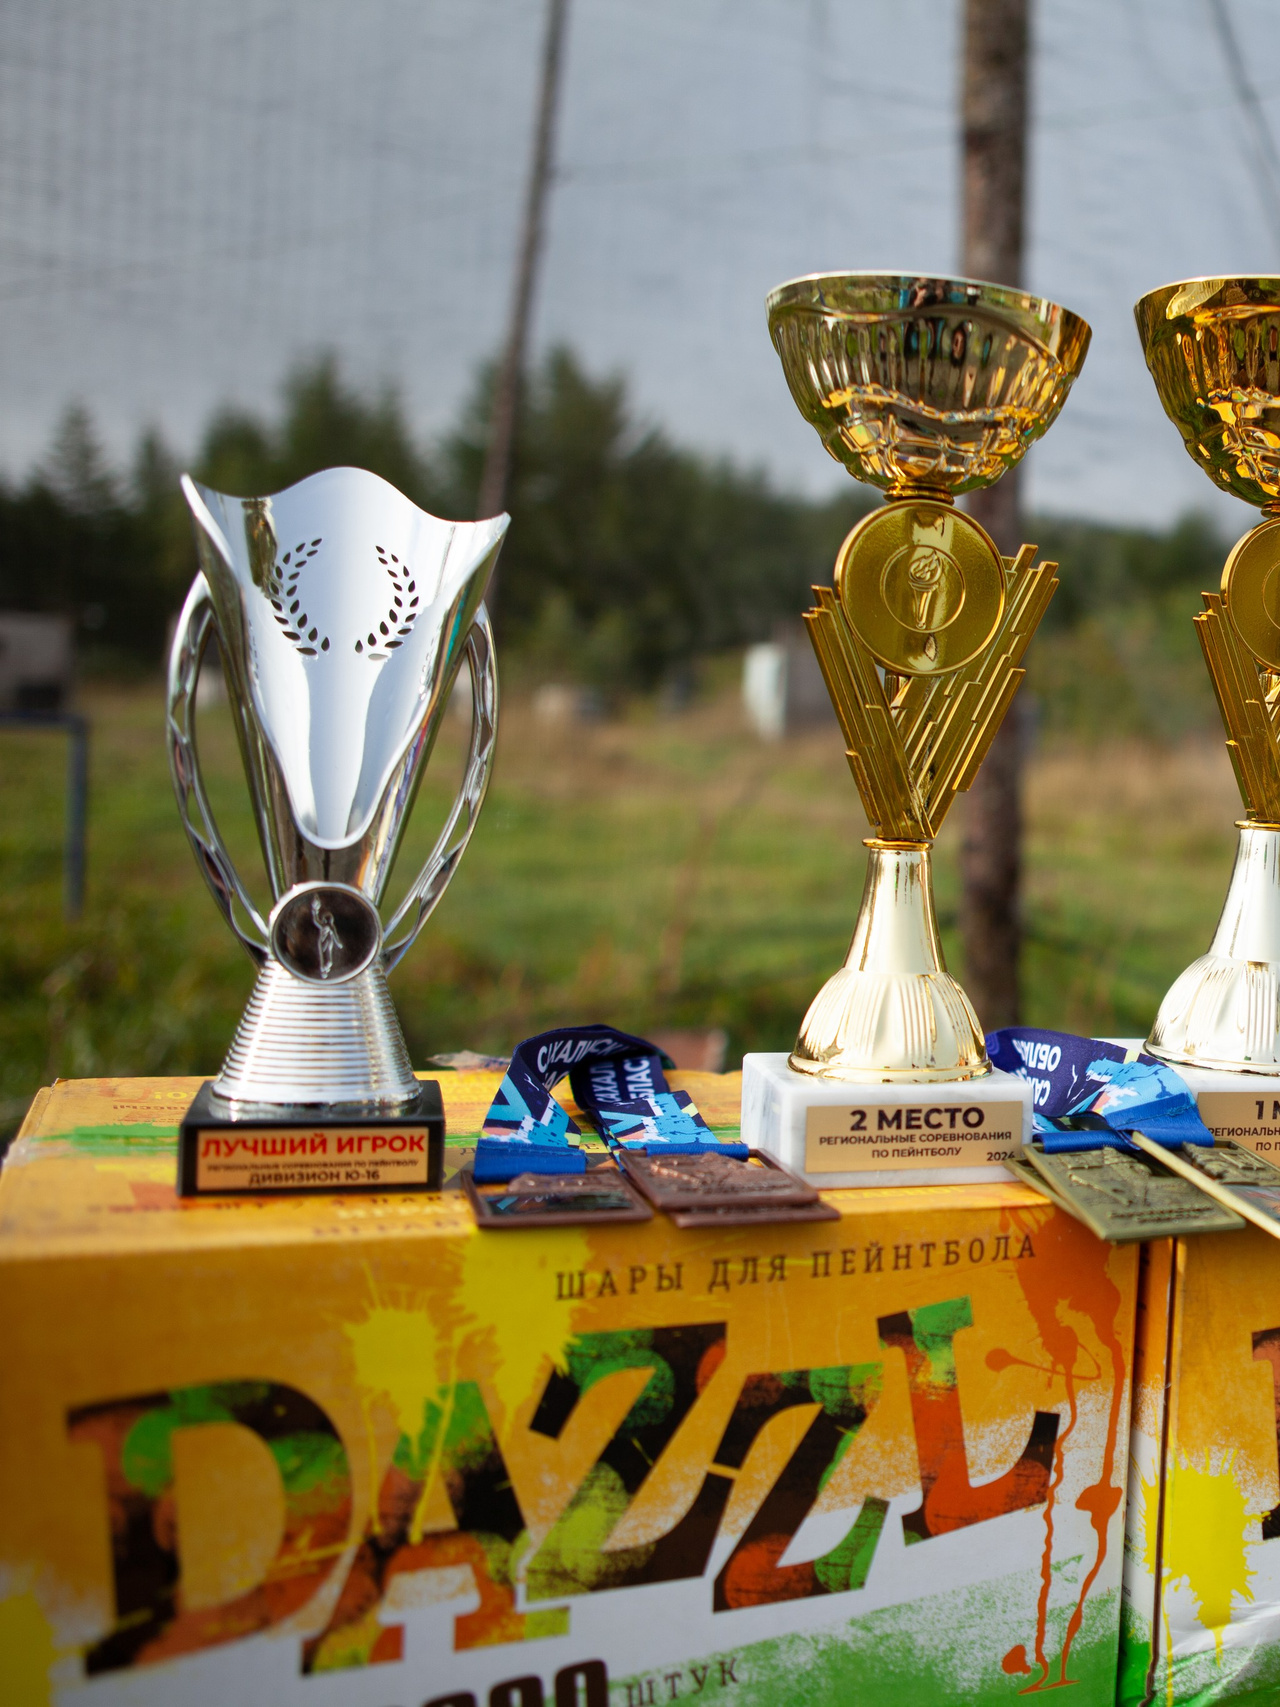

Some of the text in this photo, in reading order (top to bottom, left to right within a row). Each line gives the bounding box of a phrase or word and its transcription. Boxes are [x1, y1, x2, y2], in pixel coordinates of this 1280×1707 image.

[850, 1107, 985, 1131] 2 МЕСТО
[1255, 1100, 1263, 1120] 1
[202, 1133, 426, 1158] ЛУЧШИЙ ИГРОК
[819, 1131, 1012, 1146] РЕГИОНАЛЬНЫЕ СОРЕВНОВАНИЯ
[1255, 1142, 1272, 1151] ПО
[872, 1146, 962, 1159] ПО ПЕЙНТБОЛУ
[249, 1168, 380, 1187] ДИВИЗИОН Ю-16
[555, 1233, 1037, 1300] ШАРЫ ДЛЯ ПЕЙНТБОЛА
[625, 1657, 738, 1707] ШТУК
